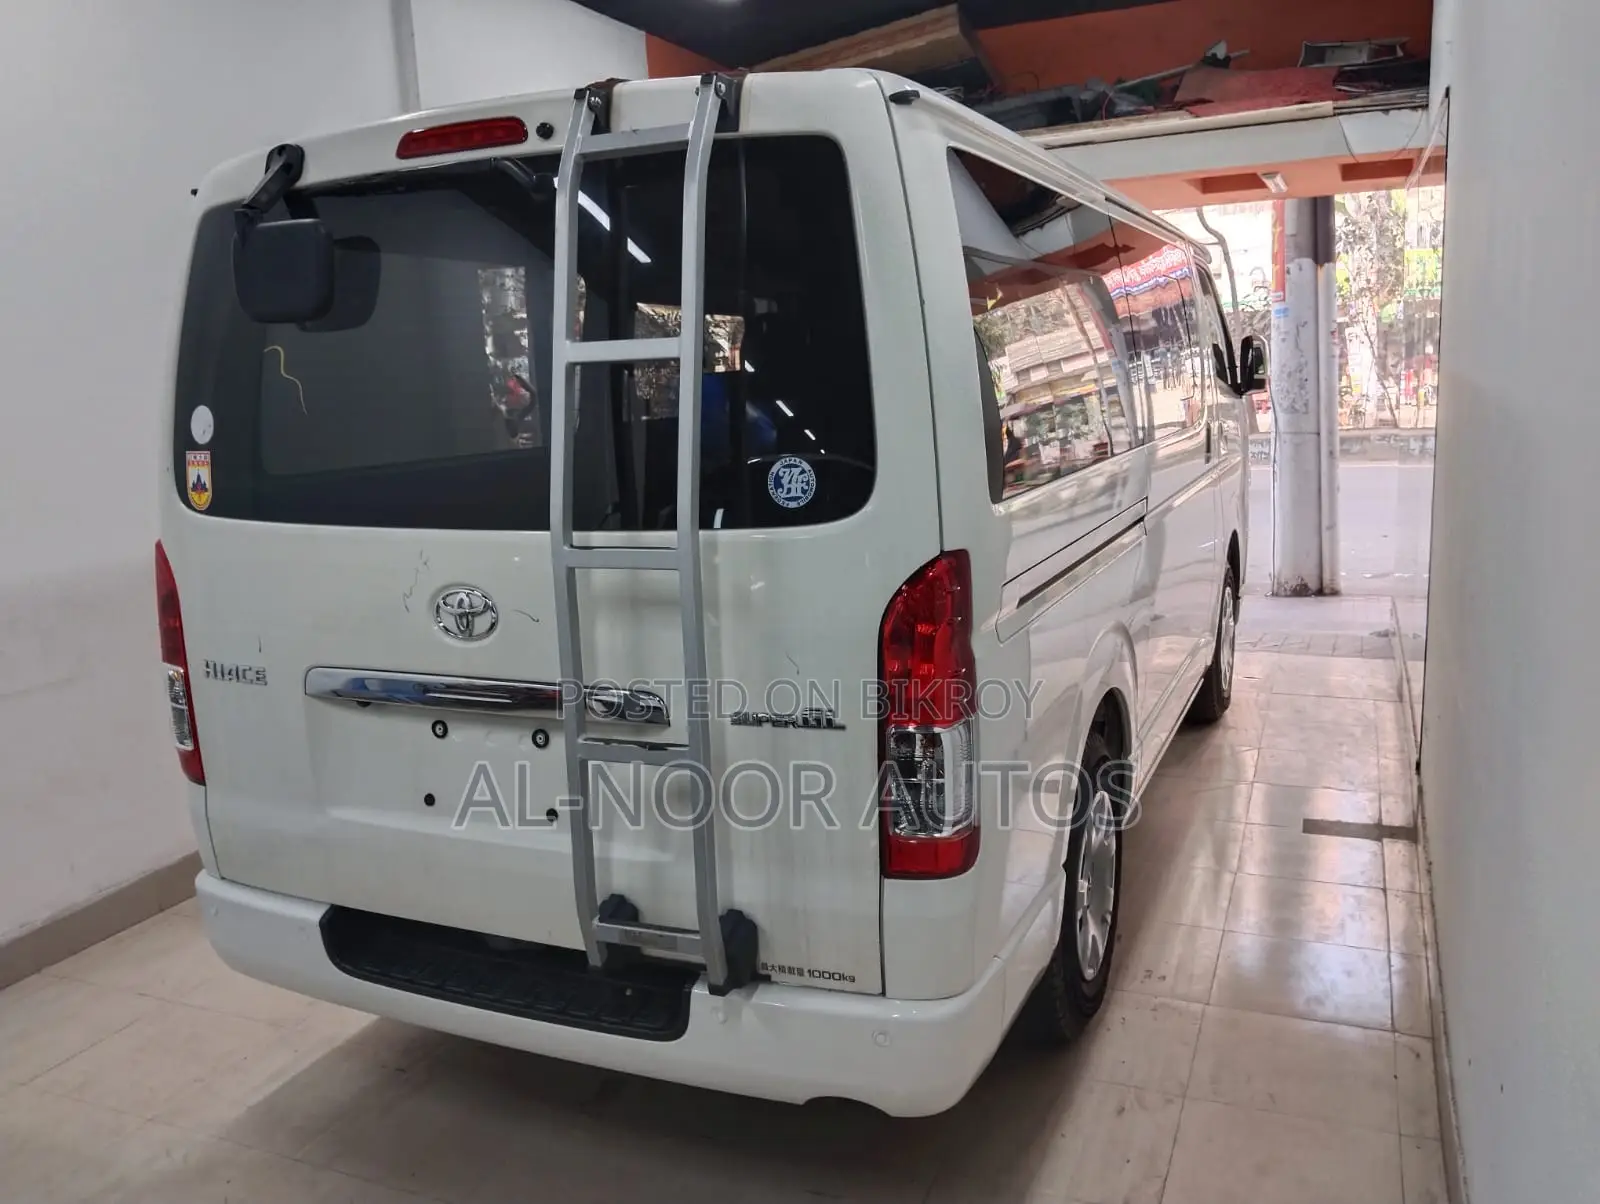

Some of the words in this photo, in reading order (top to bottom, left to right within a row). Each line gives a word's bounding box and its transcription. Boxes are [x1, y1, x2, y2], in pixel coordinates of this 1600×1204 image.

[780, 457, 803, 466] JAPAN
[204, 659, 268, 686] HIACE
[806, 968, 856, 983] 1000kg
